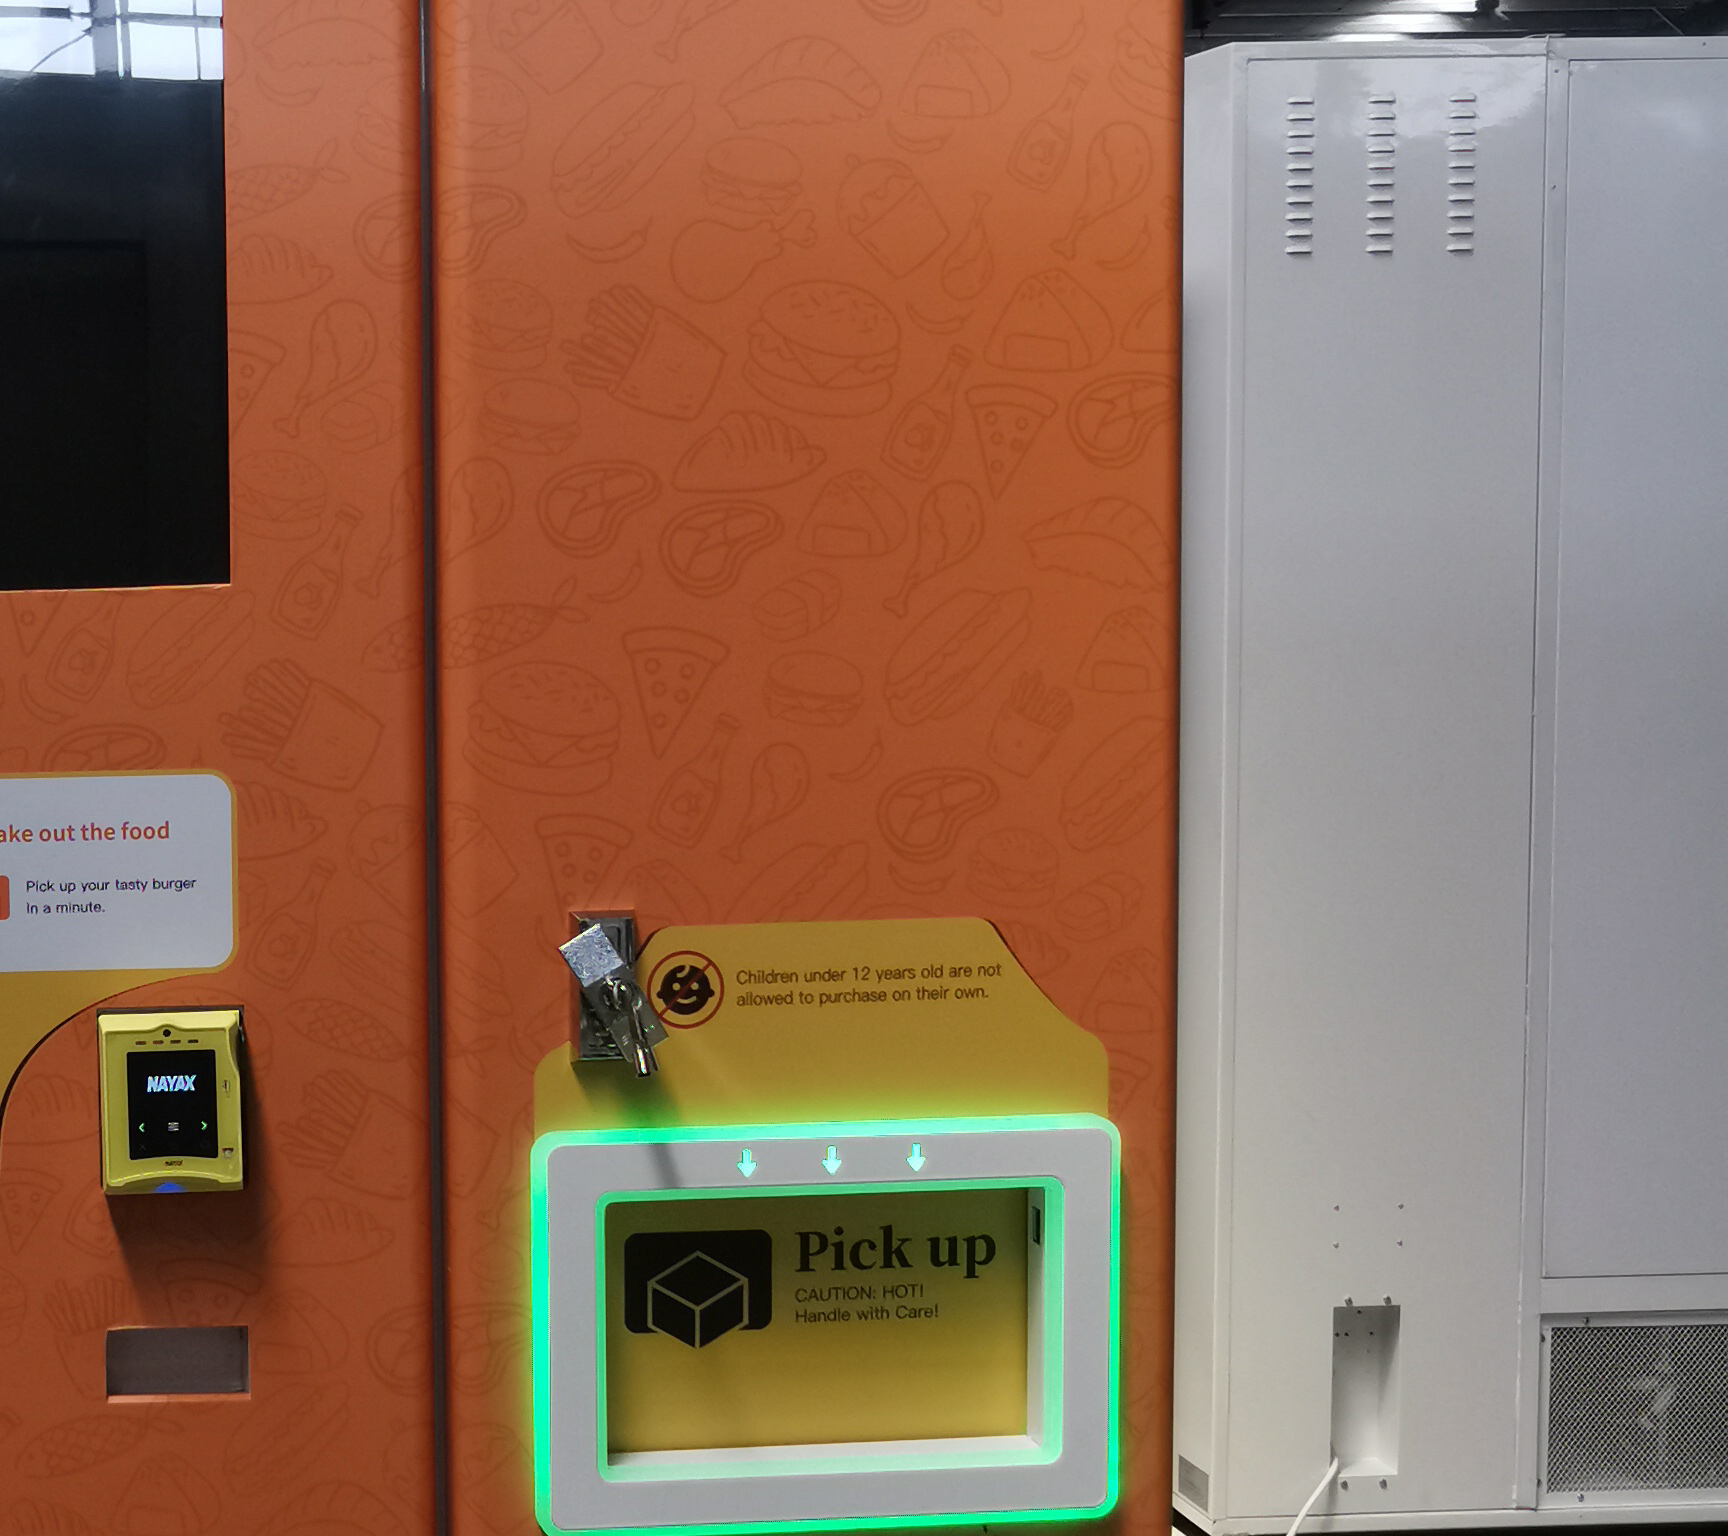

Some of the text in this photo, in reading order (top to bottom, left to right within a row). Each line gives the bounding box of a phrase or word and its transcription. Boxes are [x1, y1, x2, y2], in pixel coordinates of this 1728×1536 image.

[39, 825, 76, 842] out
[81, 822, 116, 841] the
[121, 821, 170, 840] food
[26, 877, 197, 894] Pick up your tasty burger
[26, 901, 106, 914] in a minute.
[736, 963, 1002, 985] Children under 12 years old are not
[736, 986, 989, 1007] allowed to purchase on their own.
[147, 1074, 197, 1093] NAYAX
[794, 1224, 997, 1279] Pick up
[794, 1285, 877, 1303] CAUTION:
[795, 1303, 939, 1324] Handle with Care!
